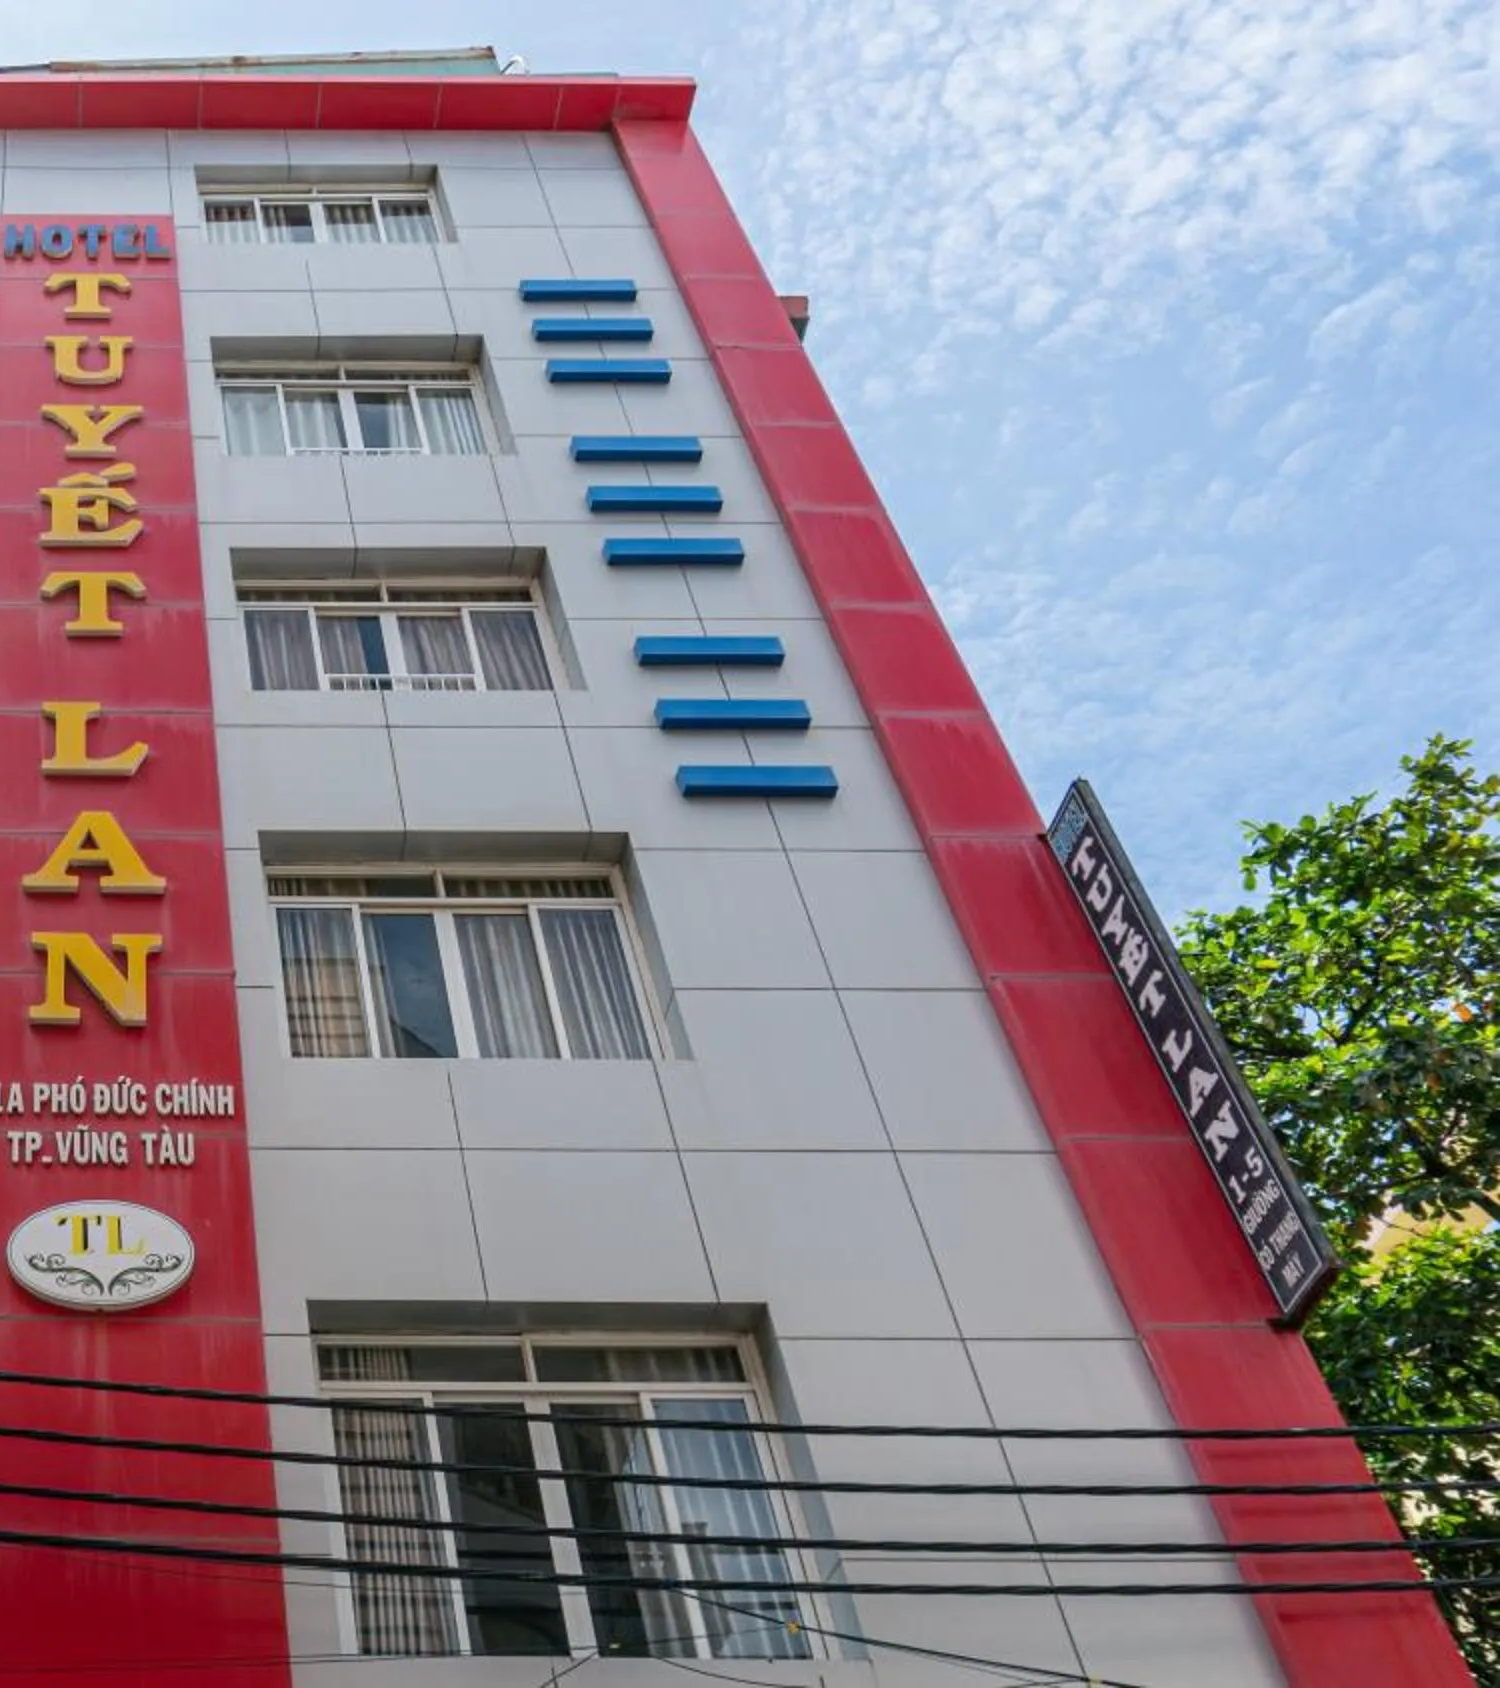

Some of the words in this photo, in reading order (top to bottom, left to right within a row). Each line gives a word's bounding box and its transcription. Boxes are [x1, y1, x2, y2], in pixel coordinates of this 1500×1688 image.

[4, 223, 171, 261] HOTEL
[38, 272, 147, 637] TUYẾT
[22, 701, 167, 1028] LAN
[33, 1076, 87, 1116] PHÓ
[94, 1076, 148, 1117] ĐỨC
[155, 1078, 235, 1117] CHÍNH
[1161, 1029, 1240, 1161] LAN
[142, 1125, 195, 1167] TÀU
[1228, 1146, 1263, 1205] 1-5
[52, 1210, 145, 1255] TL
